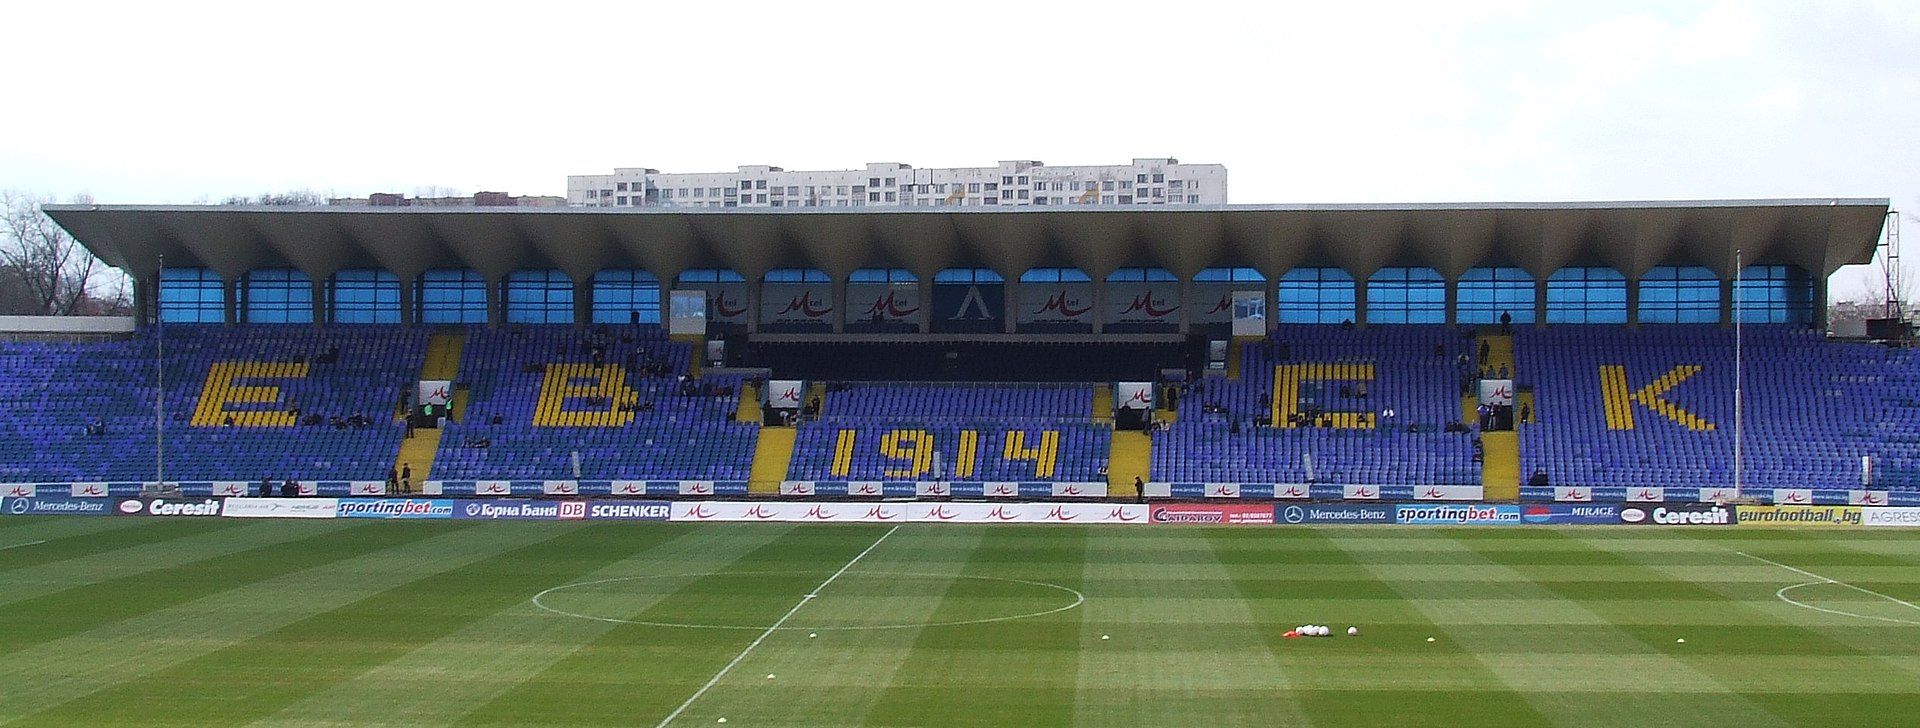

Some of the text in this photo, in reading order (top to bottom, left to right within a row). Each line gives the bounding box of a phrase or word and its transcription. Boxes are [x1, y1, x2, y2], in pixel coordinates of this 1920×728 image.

[830, 430, 1060, 478] 1914
[33, 501, 104, 511] Mercedes-Benz
[149, 499, 220, 515] Ceresit
[338, 499, 453, 516] sportingbet.com
[481, 504, 557, 518] Горна Баня
[561, 504, 669, 517] DB SCHENKER
[1571, 507, 1614, 516] MIRAGE
[1310, 509, 1386, 520] Mercedes-Benz
[1397, 505, 1519, 524] sportingbet.com
[1653, 506, 1728, 524] Ceresit
[1739, 508, 1862, 524] eurofootball.bg
